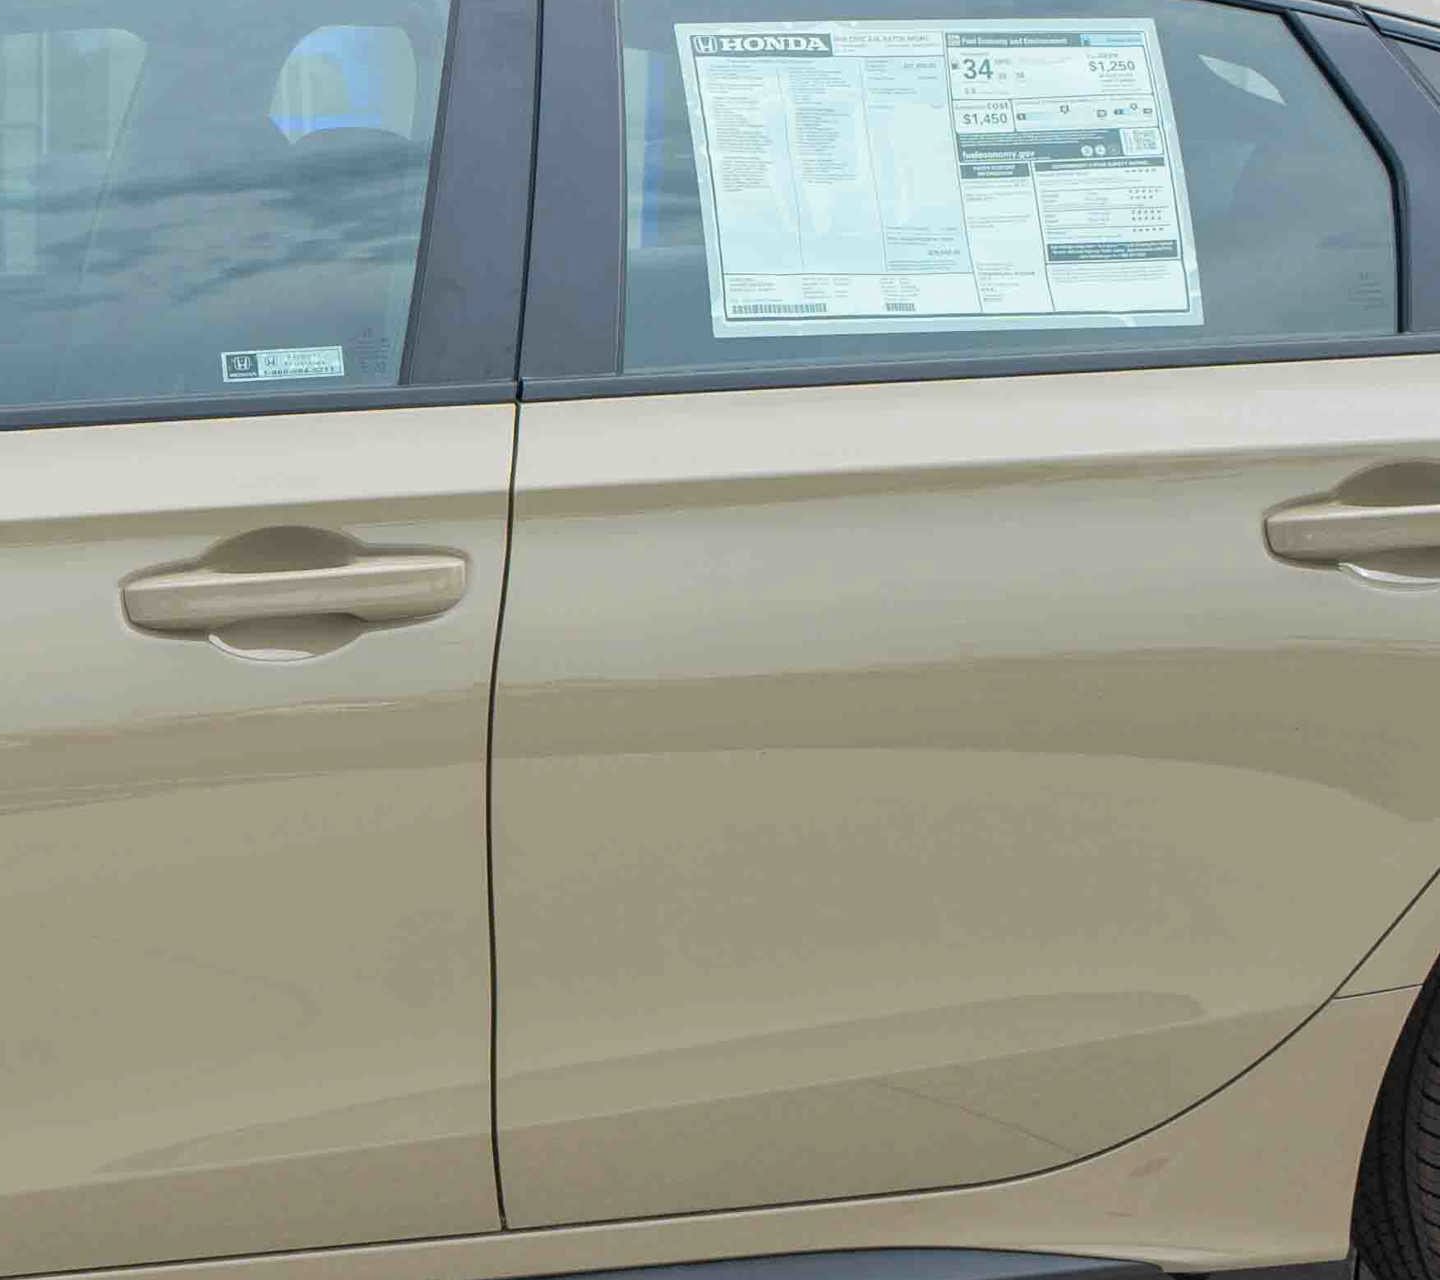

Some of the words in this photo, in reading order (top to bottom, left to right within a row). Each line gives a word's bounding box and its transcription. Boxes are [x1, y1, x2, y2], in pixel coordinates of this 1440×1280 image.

[720, 36, 830, 52] HONDA
[963, 58, 994, 80] 34
[1088, 60, 1135, 73] $1,250
[963, 113, 1008, 126] $1,450
